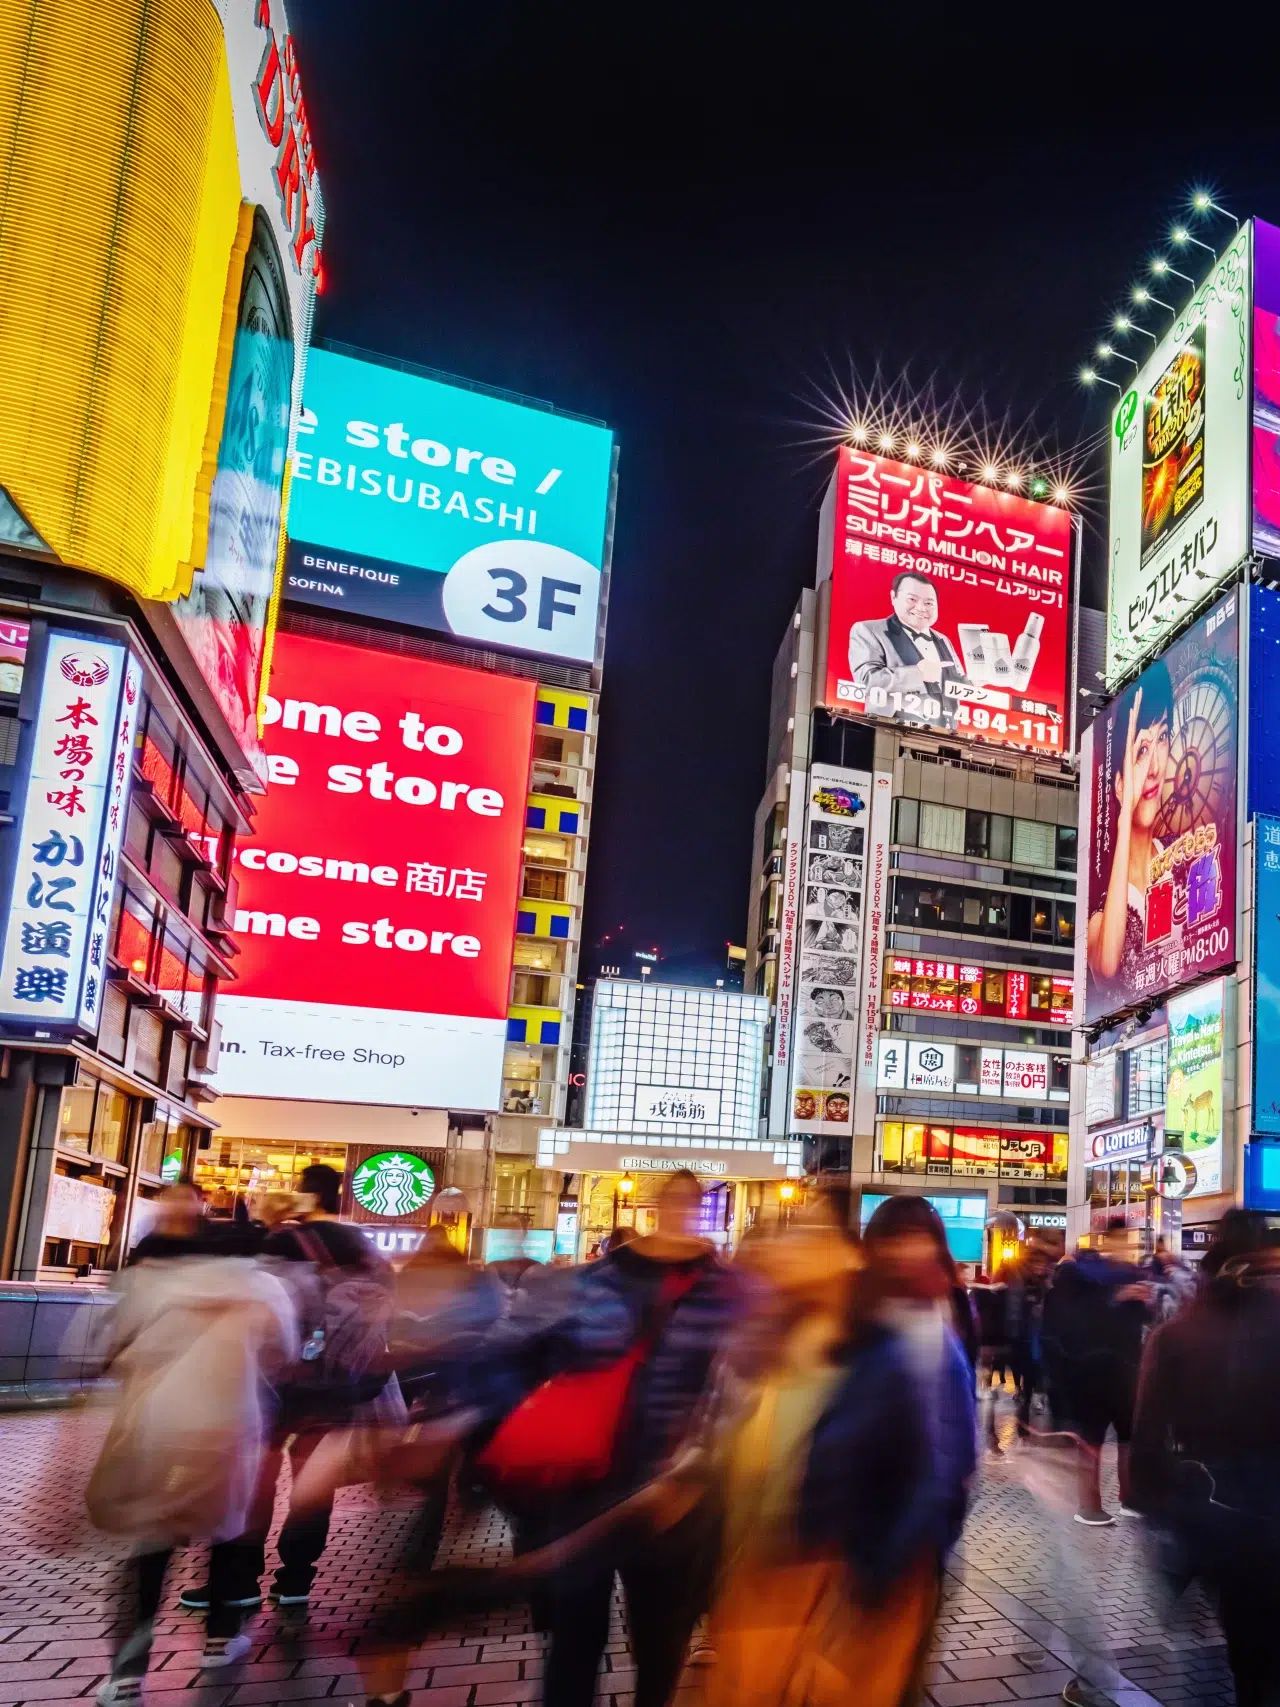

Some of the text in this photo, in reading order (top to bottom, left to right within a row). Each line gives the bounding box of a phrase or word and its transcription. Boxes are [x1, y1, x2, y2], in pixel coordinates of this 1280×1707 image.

[346, 420, 516, 486] store
[291, 450, 537, 535] EBISUBASHI
[849, 456, 972, 505] スーパー
[847, 483, 1063, 557] ミリオンヘアー
[303, 555, 400, 585] BENEFIQUE
[845, 514, 1063, 586] SUPER MILLION HAIR
[289, 576, 344, 596] SOFINA
[1128, 516, 1218, 632] ピップエレキバン
[481, 567, 582, 632] 3F
[949, 684, 988, 700] ルアン
[399, 712, 463, 756] to
[869, 687, 1059, 744] 0120-494-111
[46, 697, 99, 818] 本場の味
[327, 761, 504, 817] store
[342, 918, 481, 958] store
[892, 991, 910, 1005] 5F
[259, 1040, 345, 1063] Tax-free
[353, 1048, 406, 1068] Shop
[982, 1058, 1046, 1073] 女性のお客様
[1021, 1073, 1047, 1089] 0円
[649, 1102, 705, 1120] 戎橋筋
